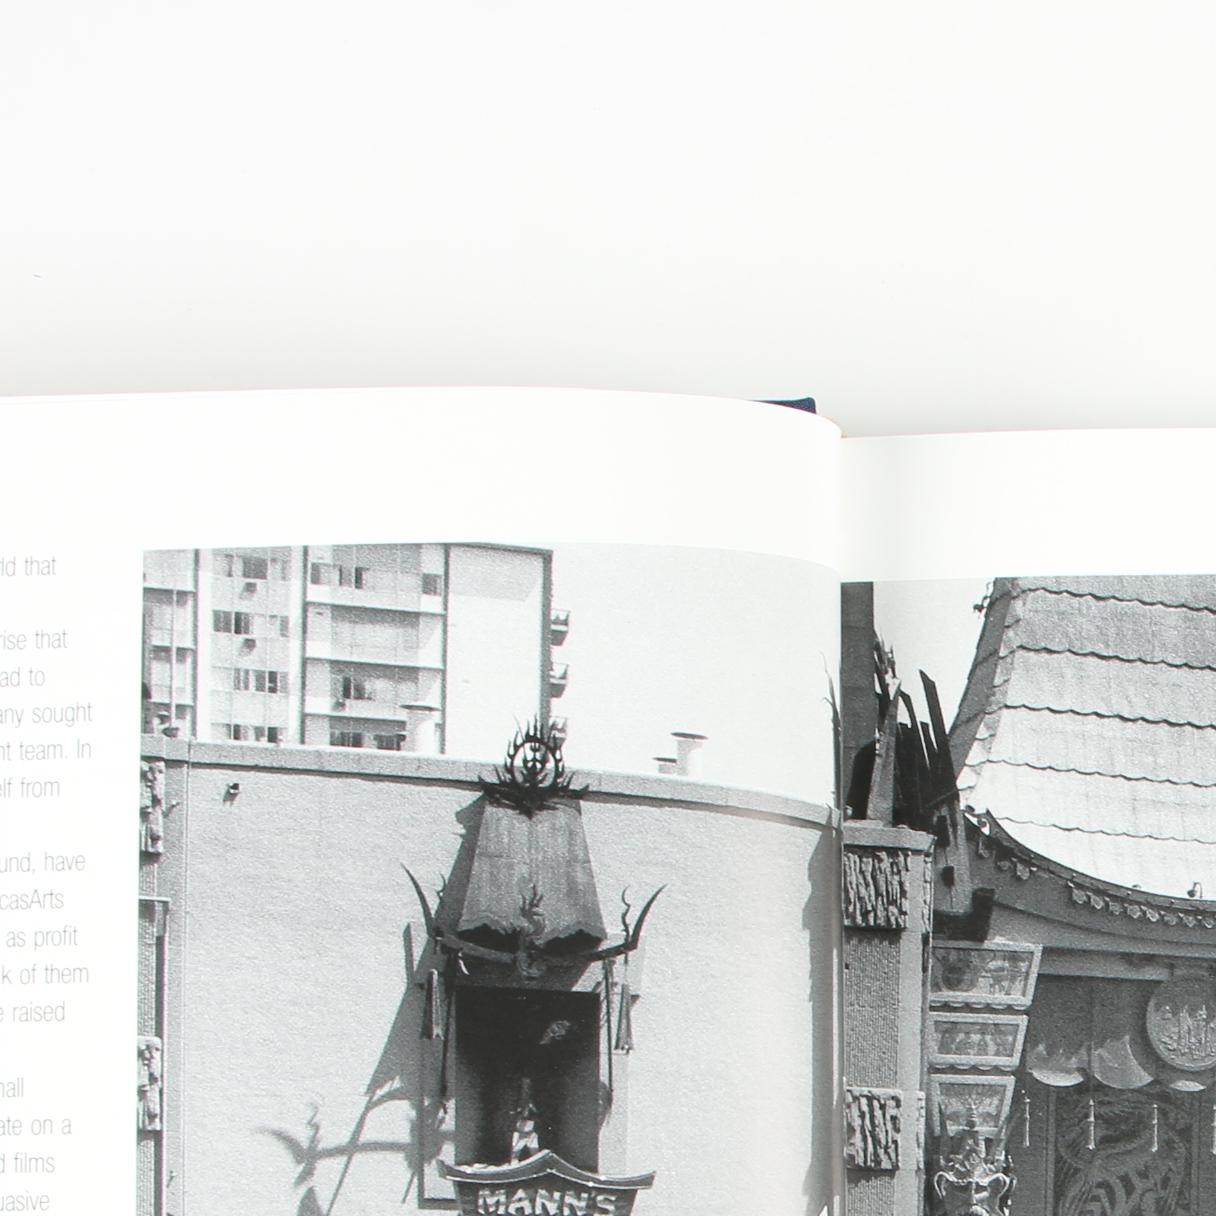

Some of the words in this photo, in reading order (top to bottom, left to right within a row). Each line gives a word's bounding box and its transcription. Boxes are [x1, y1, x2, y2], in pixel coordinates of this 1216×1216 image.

[24, 556, 56, 576] that
[35, 629, 68, 649] that
[28, 667, 45, 687] to
[32, 702, 92, 728] sought
[19, 741, 68, 760] team.
[77, 739, 92, 758] In
[20, 776, 60, 798] from
[44, 852, 86, 871] have
[0, 889, 64, 910] casArts
[6, 931, 26, 948] as
[34, 925, 78, 950] profit
[20, 964, 36, 985] of
[44, 964, 89, 984] them
[13, 1001, 65, 1022] raised
[31, 1119, 53, 1136] on
[61, 1118, 72, 1135] a
[14, 1152, 55, 1173] films
